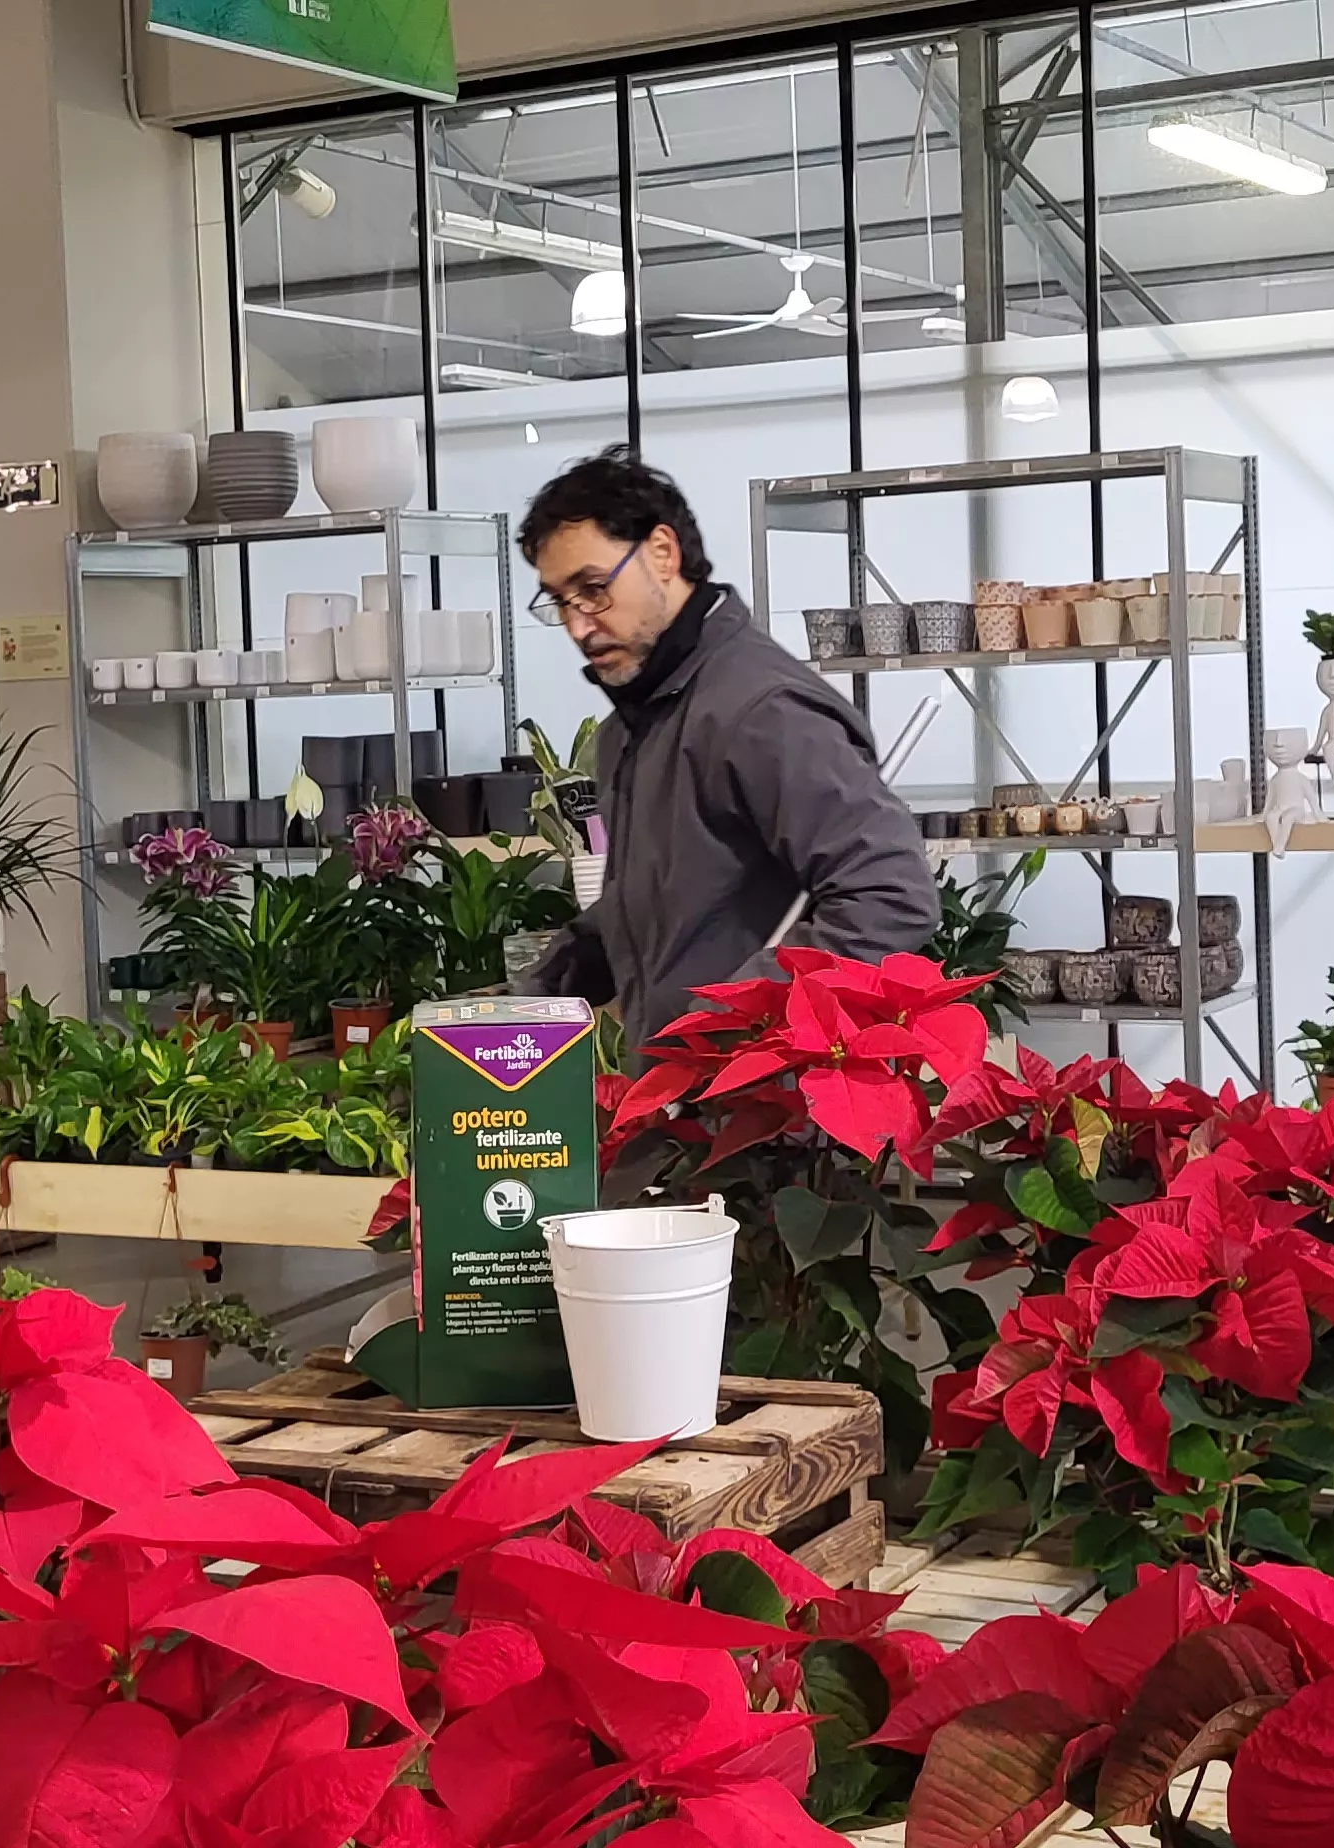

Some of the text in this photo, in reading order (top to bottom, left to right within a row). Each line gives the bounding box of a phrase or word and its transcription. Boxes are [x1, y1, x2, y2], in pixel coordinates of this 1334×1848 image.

[474, 1045, 543, 1061] Fertiberia
[506, 1060, 532, 1070] Jardín
[452, 1107, 528, 1135] gotero
[475, 1129, 563, 1147] fertilizante
[476, 1145, 569, 1170] universal
[452, 1251, 499, 1262] Fertilizante
[500, 1252, 520, 1262] para
[521, 1249, 541, 1259] todo
[452, 1265, 484, 1276] plantas
[484, 1266, 491, 1275] y
[492, 1263, 516, 1272] flores
[516, 1262, 528, 1271] de
[469, 1276, 499, 1286] directa
[499, 1277, 511, 1285] en
[512, 1274, 520, 1284] el
